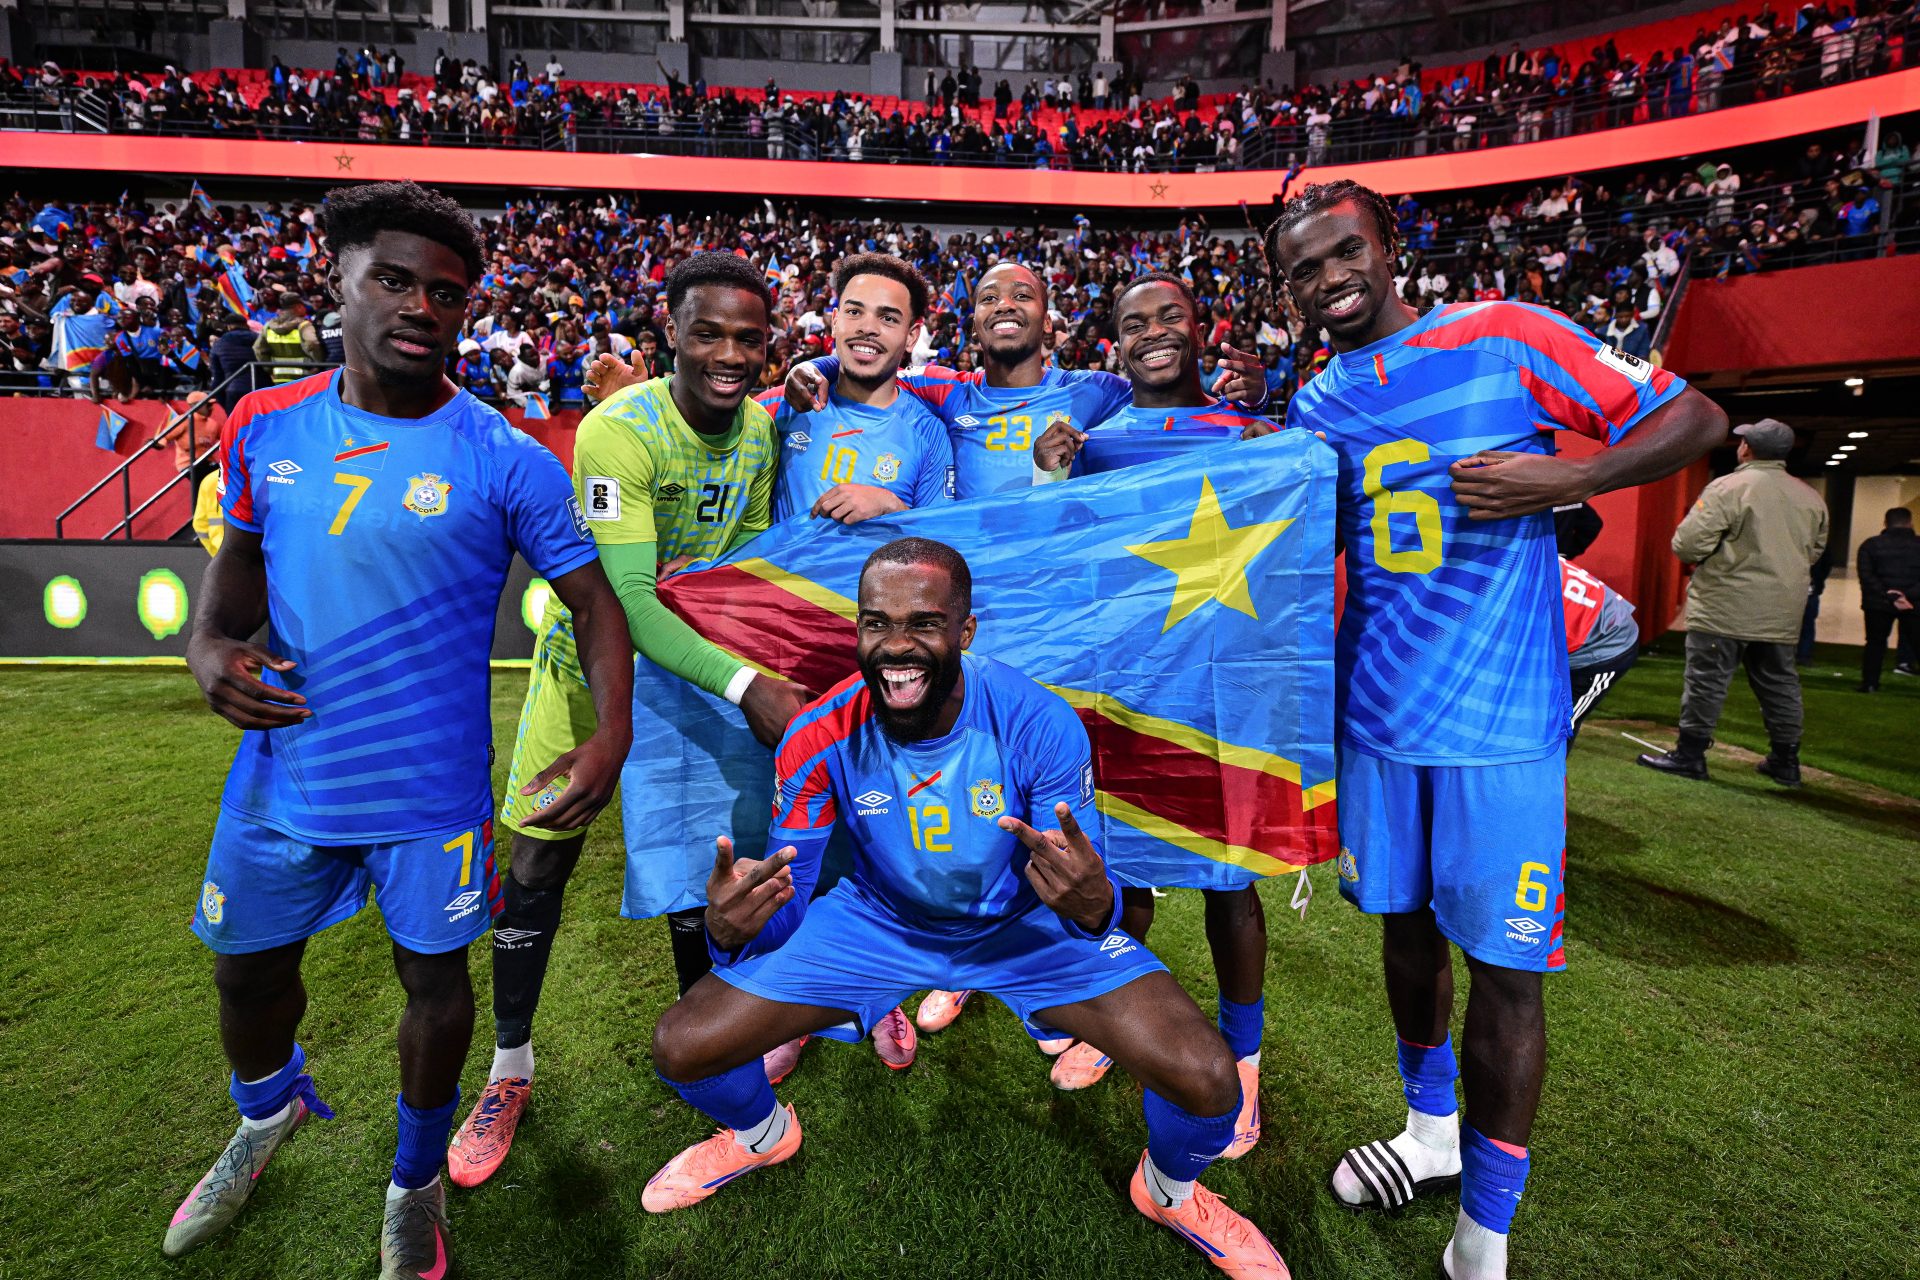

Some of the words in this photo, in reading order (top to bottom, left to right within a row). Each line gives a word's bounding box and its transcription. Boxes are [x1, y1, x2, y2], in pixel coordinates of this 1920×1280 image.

[788, 441, 807, 451] umbro
[986, 415, 1032, 451] 23
[820, 444, 859, 485] 10
[266, 475, 295, 485] umbro
[328, 472, 373, 536] 7
[409, 503, 439, 513] FECOFA
[697, 484, 730, 522] 21
[1362, 438, 1444, 575] 6
[857, 807, 889, 816] umbro
[977, 807, 1000, 816] FECOFA
[907, 805, 953, 852] 12
[443, 831, 474, 887] 7
[1515, 861, 1550, 912] 6
[448, 903, 480, 923] umbro
[1505, 930, 1540, 945] umbro
[1109, 945, 1137, 959] umbro
